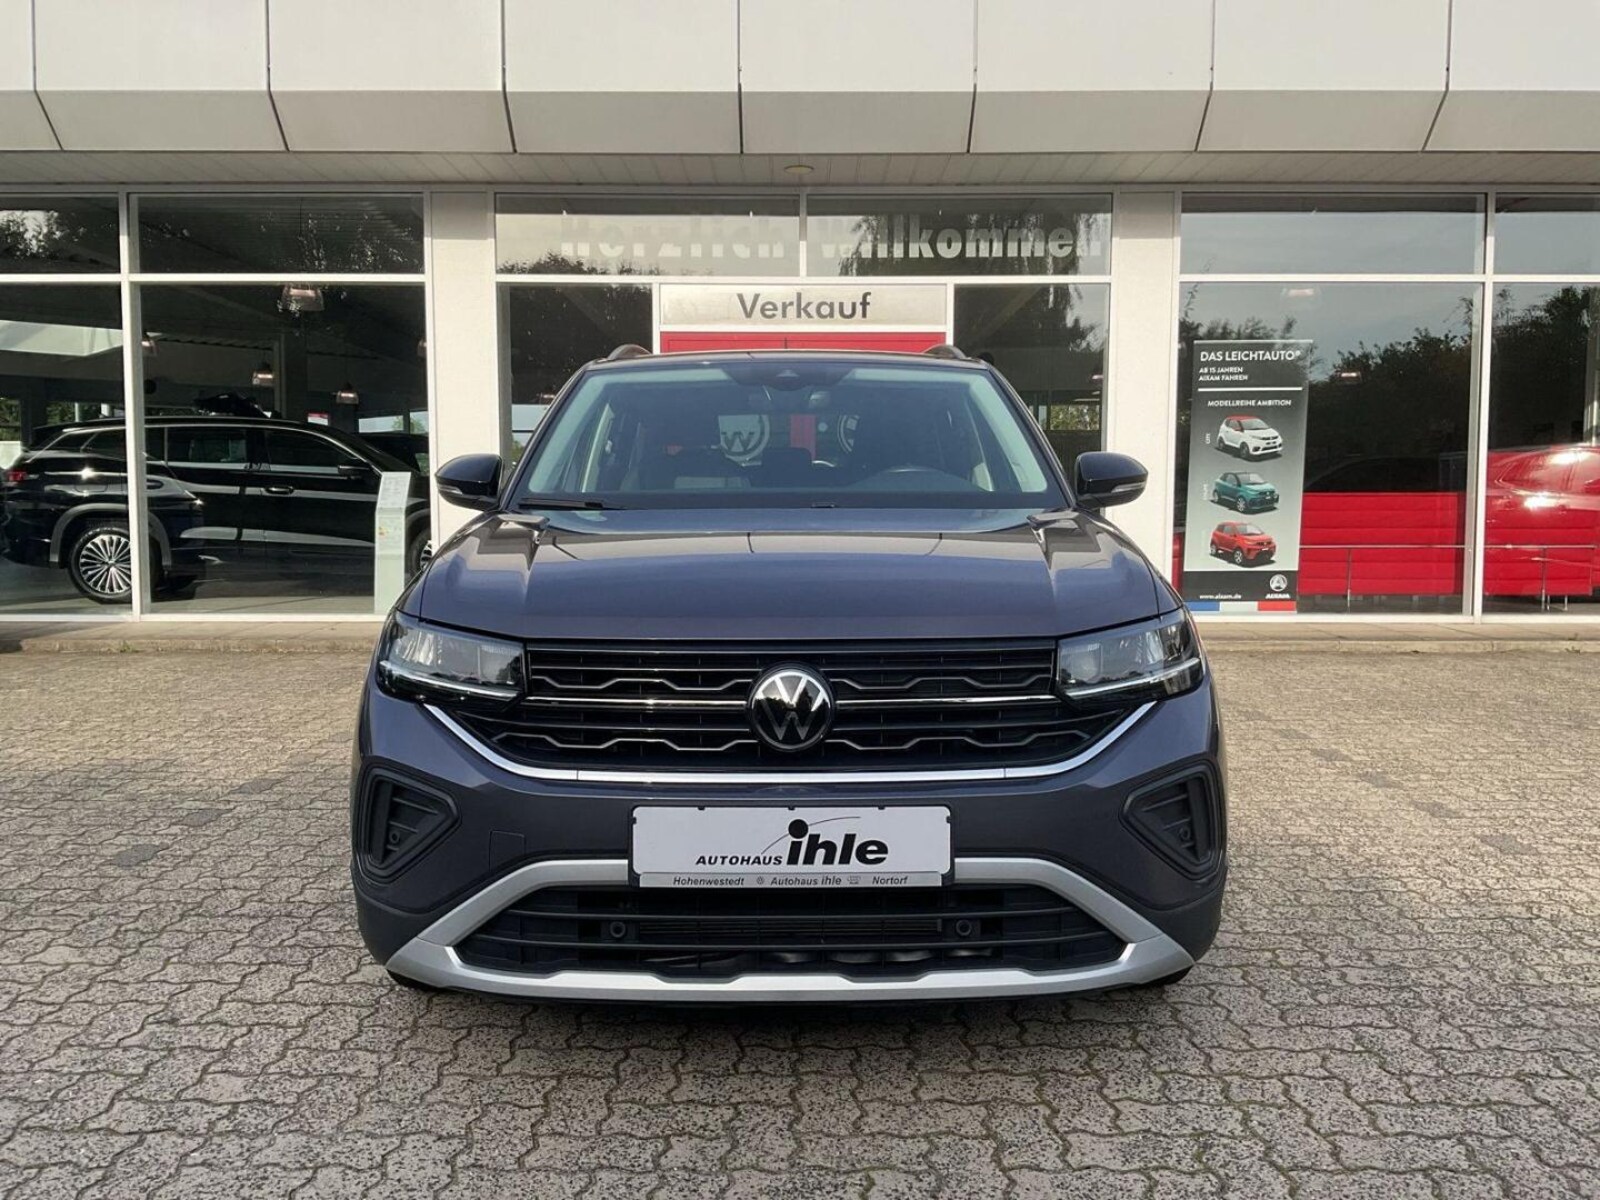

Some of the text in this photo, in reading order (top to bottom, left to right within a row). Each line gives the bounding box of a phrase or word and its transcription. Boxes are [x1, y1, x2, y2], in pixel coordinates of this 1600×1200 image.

[561, 214, 1102, 259] Herzlich Willkommen
[737, 291, 872, 320] Verkauf
[1200, 351, 1223, 361] DAS
[695, 818, 889, 866] AUTOHAUS ihle
[673, 876, 745, 887] Hohenwestedt
[770, 876, 818, 887] Autohaus
[821, 875, 842, 886] ihle
[872, 875, 908, 886] Nortorf
